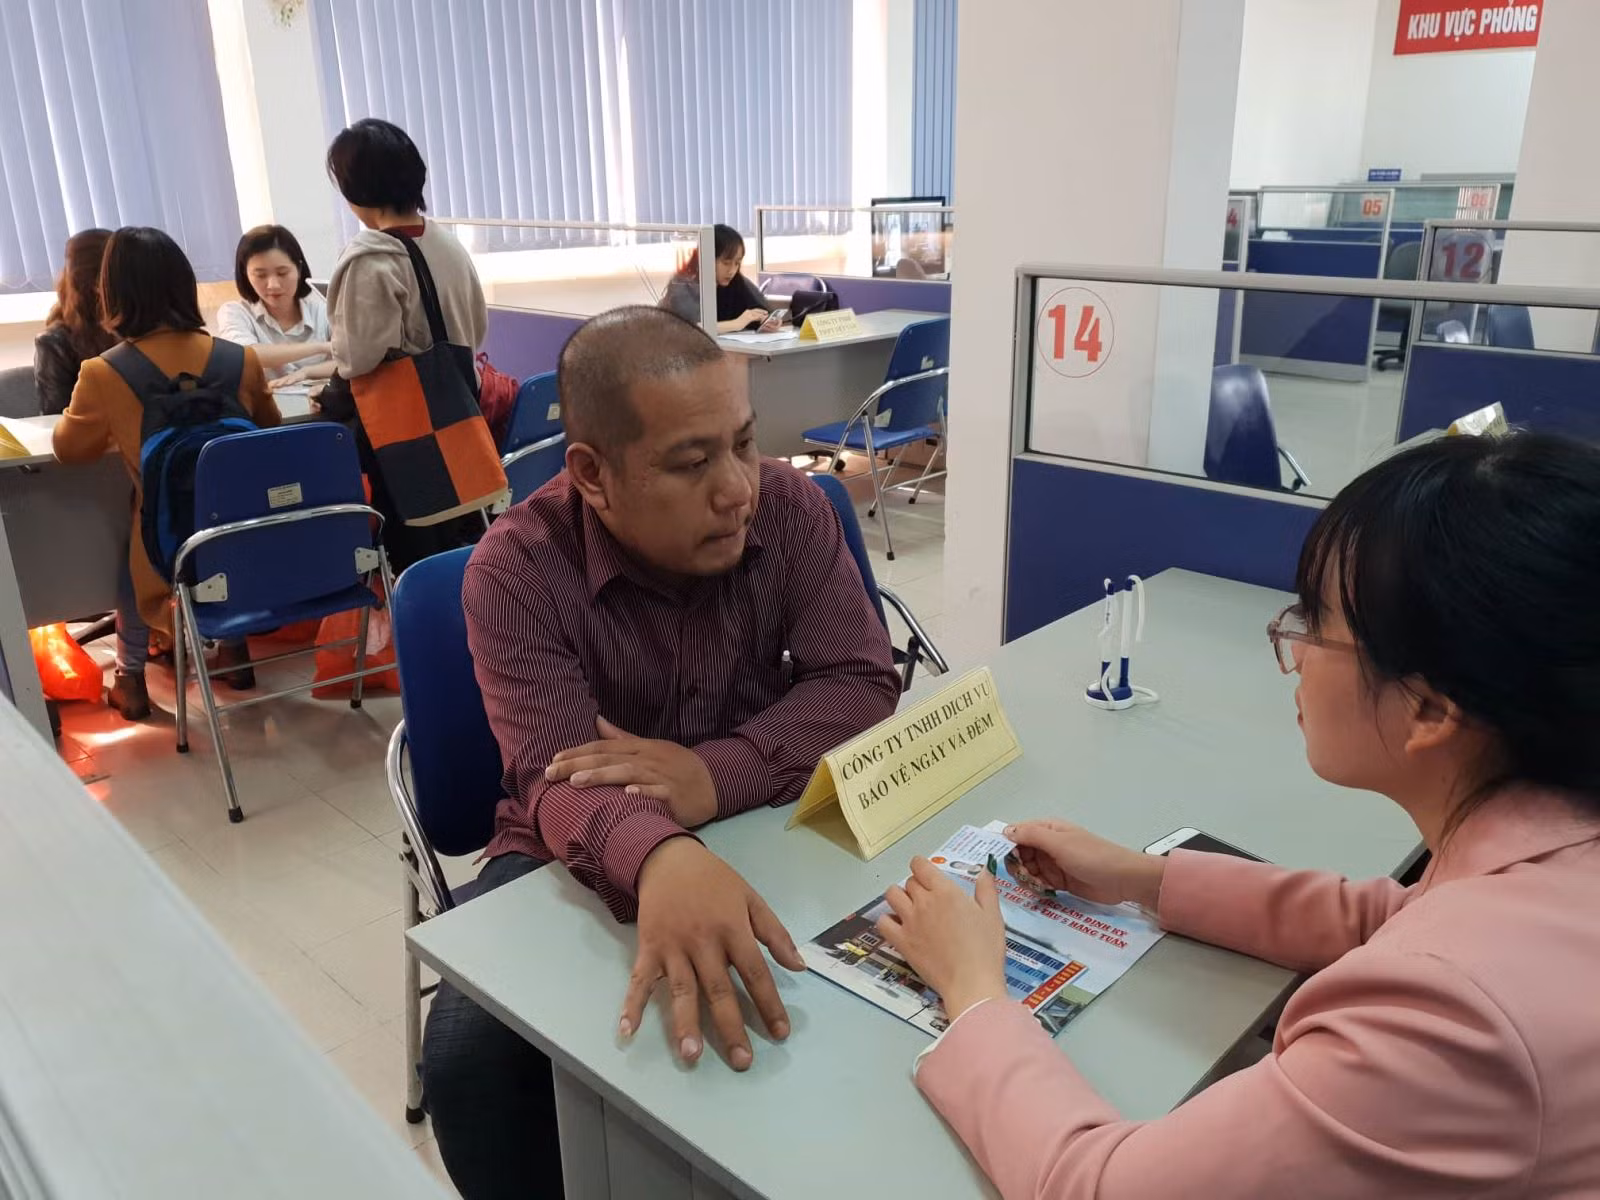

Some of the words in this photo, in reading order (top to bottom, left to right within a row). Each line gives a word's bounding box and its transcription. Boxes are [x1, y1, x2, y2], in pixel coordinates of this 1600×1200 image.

[1407, 12, 1441, 40] KHU
[1445, 8, 1476, 42] VỰC
[1227, 208, 1238, 227] 4
[1362, 199, 1382, 216] 05
[1441, 242, 1485, 280] 12
[1048, 304, 1102, 362] 14
[842, 745, 884, 781] CÔNG
[884, 732, 903, 755] TY
[904, 710, 942, 742] TNHH
[941, 691, 973, 720] DỊCH
[973, 680, 991, 699] VỤ
[890, 763, 911, 787] VỆ
[910, 744, 947, 776] NGÀY
[948, 727, 967, 751] VÀ
[966, 713, 995, 740] ĐÊM
